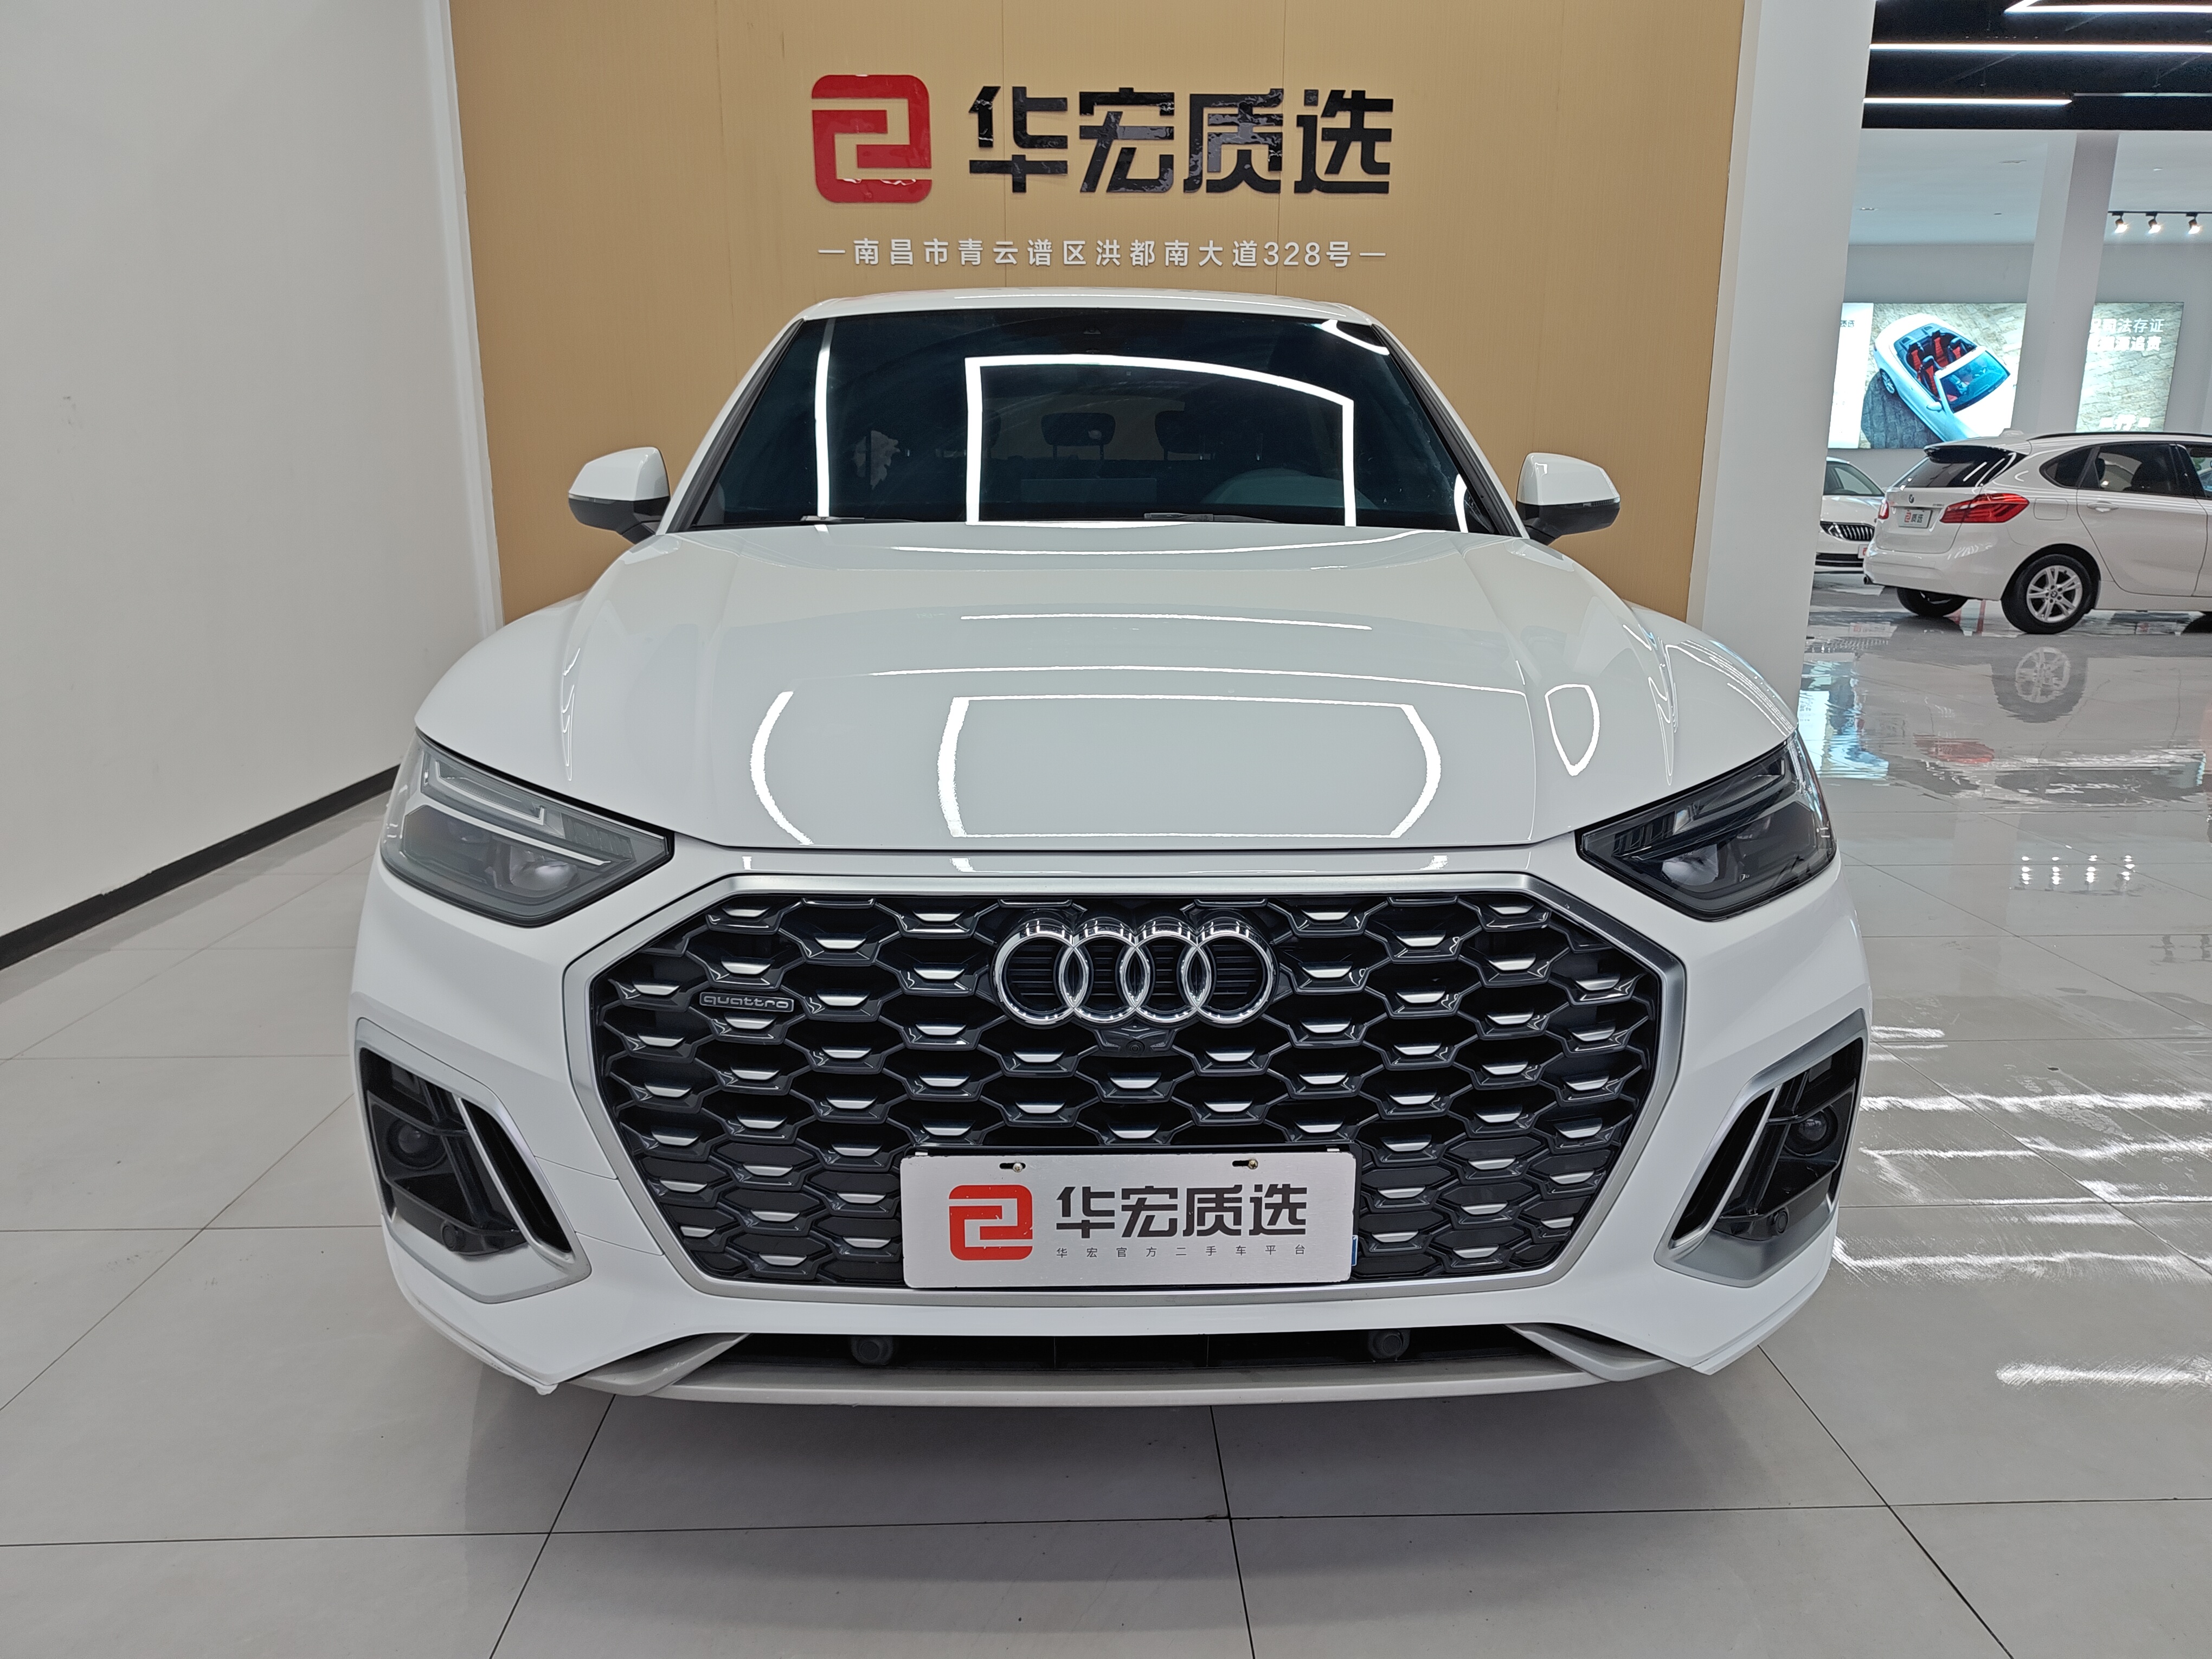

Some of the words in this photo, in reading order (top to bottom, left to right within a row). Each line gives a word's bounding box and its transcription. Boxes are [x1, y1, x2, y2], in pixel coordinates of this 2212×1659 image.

[968, 86, 1394, 194] 华宏质选
[703, 995, 789, 1009] quattro
[1056, 1184, 1308, 1239] 华宏质选
[1056, 1244, 1306, 1259] 华宏官方二手车平台
